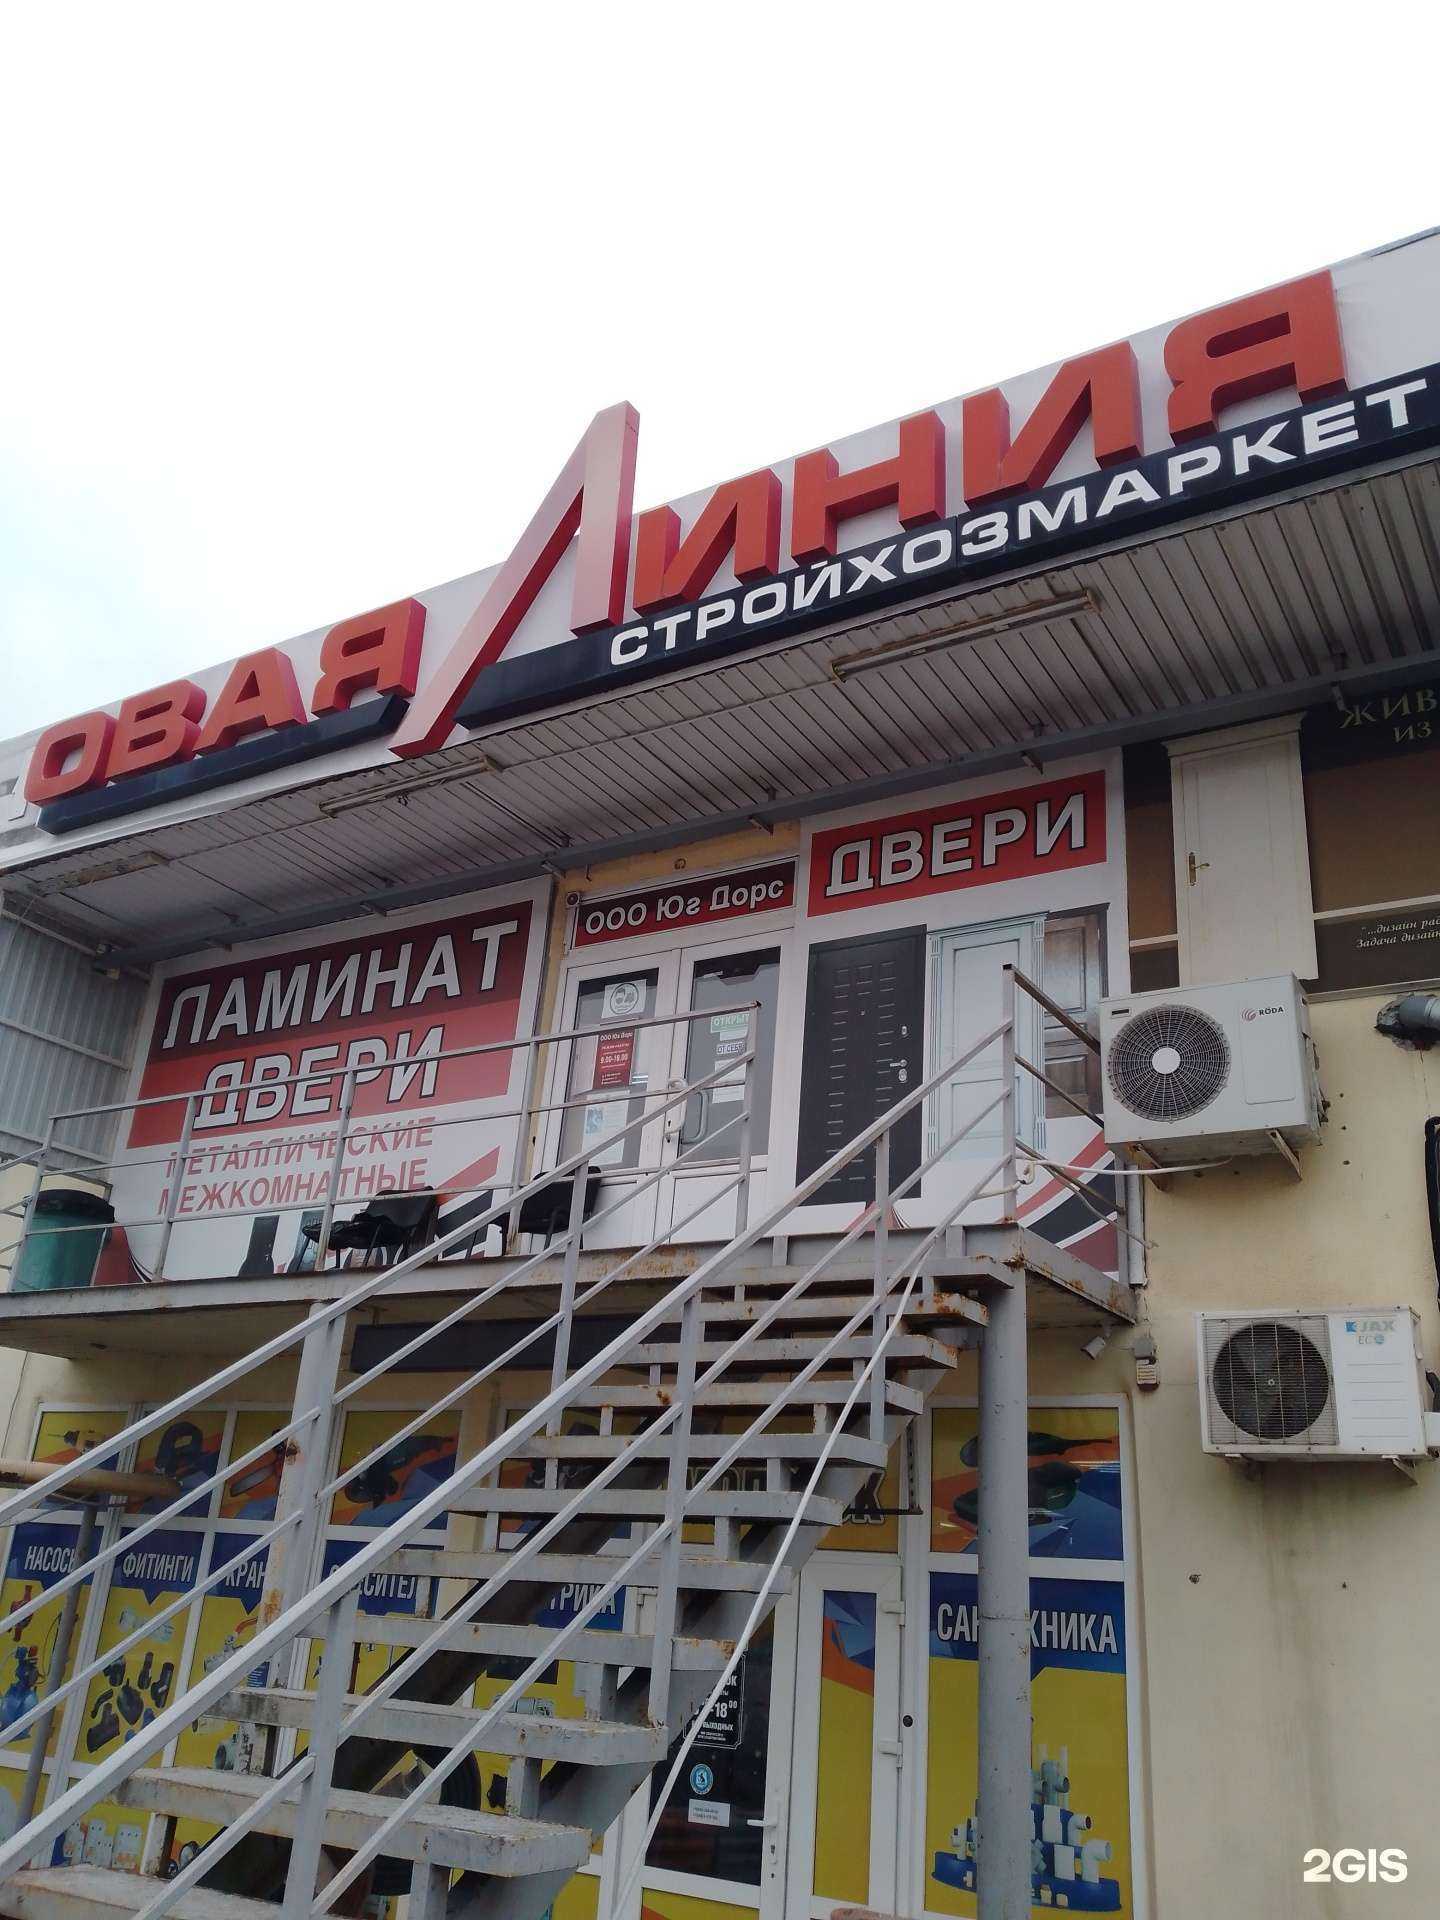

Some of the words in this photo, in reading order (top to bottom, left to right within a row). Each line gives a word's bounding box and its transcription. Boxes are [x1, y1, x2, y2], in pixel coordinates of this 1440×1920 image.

[389, 268, 1348, 758] ЛИНИЯ
[610, 377, 1431, 667] СТРОЙХОЗМАРКЕТ
[825, 793, 1087, 898] ДВЕРИ
[584, 903, 647, 935] ООО
[708, 876, 785, 914] Дорс
[161, 920, 519, 1050] ЛАМИНАТ
[193, 1024, 447, 1132] ДВЕРИ
[24, 1545, 80, 1573] НАСОС
[122, 1552, 195, 1583] ФИТИНГИ
